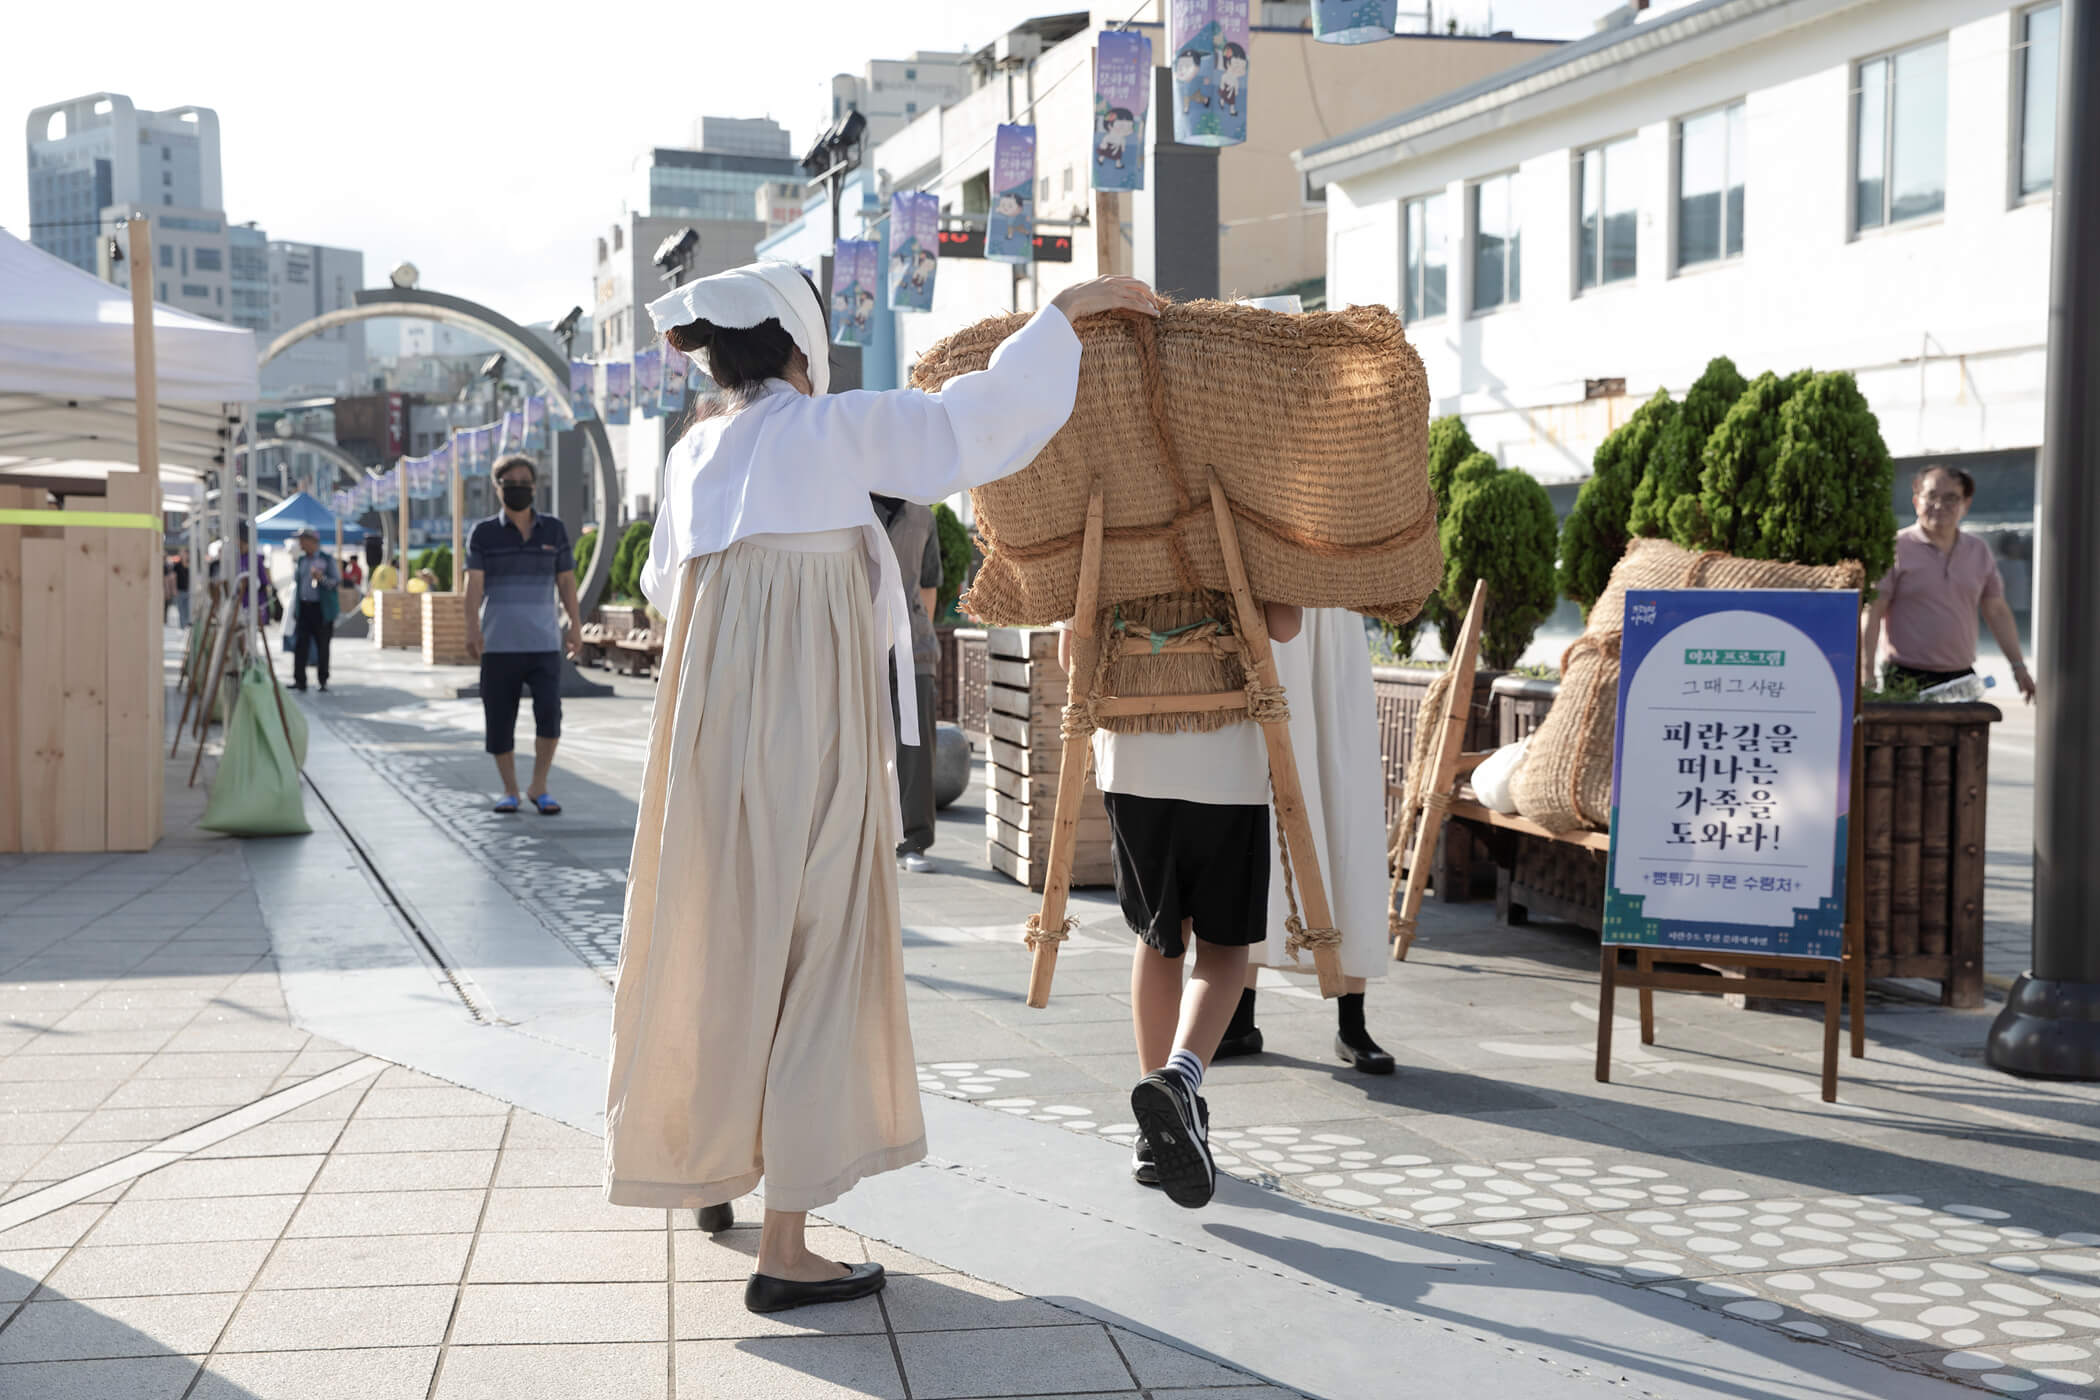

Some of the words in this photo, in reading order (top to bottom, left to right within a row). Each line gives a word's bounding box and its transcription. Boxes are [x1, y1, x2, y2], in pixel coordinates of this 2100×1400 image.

[1722, 651, 1782, 667] 프로그램
[1662, 721, 1798, 754] 피란길을
[1678, 754, 1778, 785] 떠나는
[1675, 786, 1777, 819] 가족을
[1666, 821, 1780, 852] 도와라!
[1653, 871, 1700, 887] 뻥튀기
[1706, 874, 1737, 889] 쿠폰
[1743, 876, 1792, 892] 수령처
